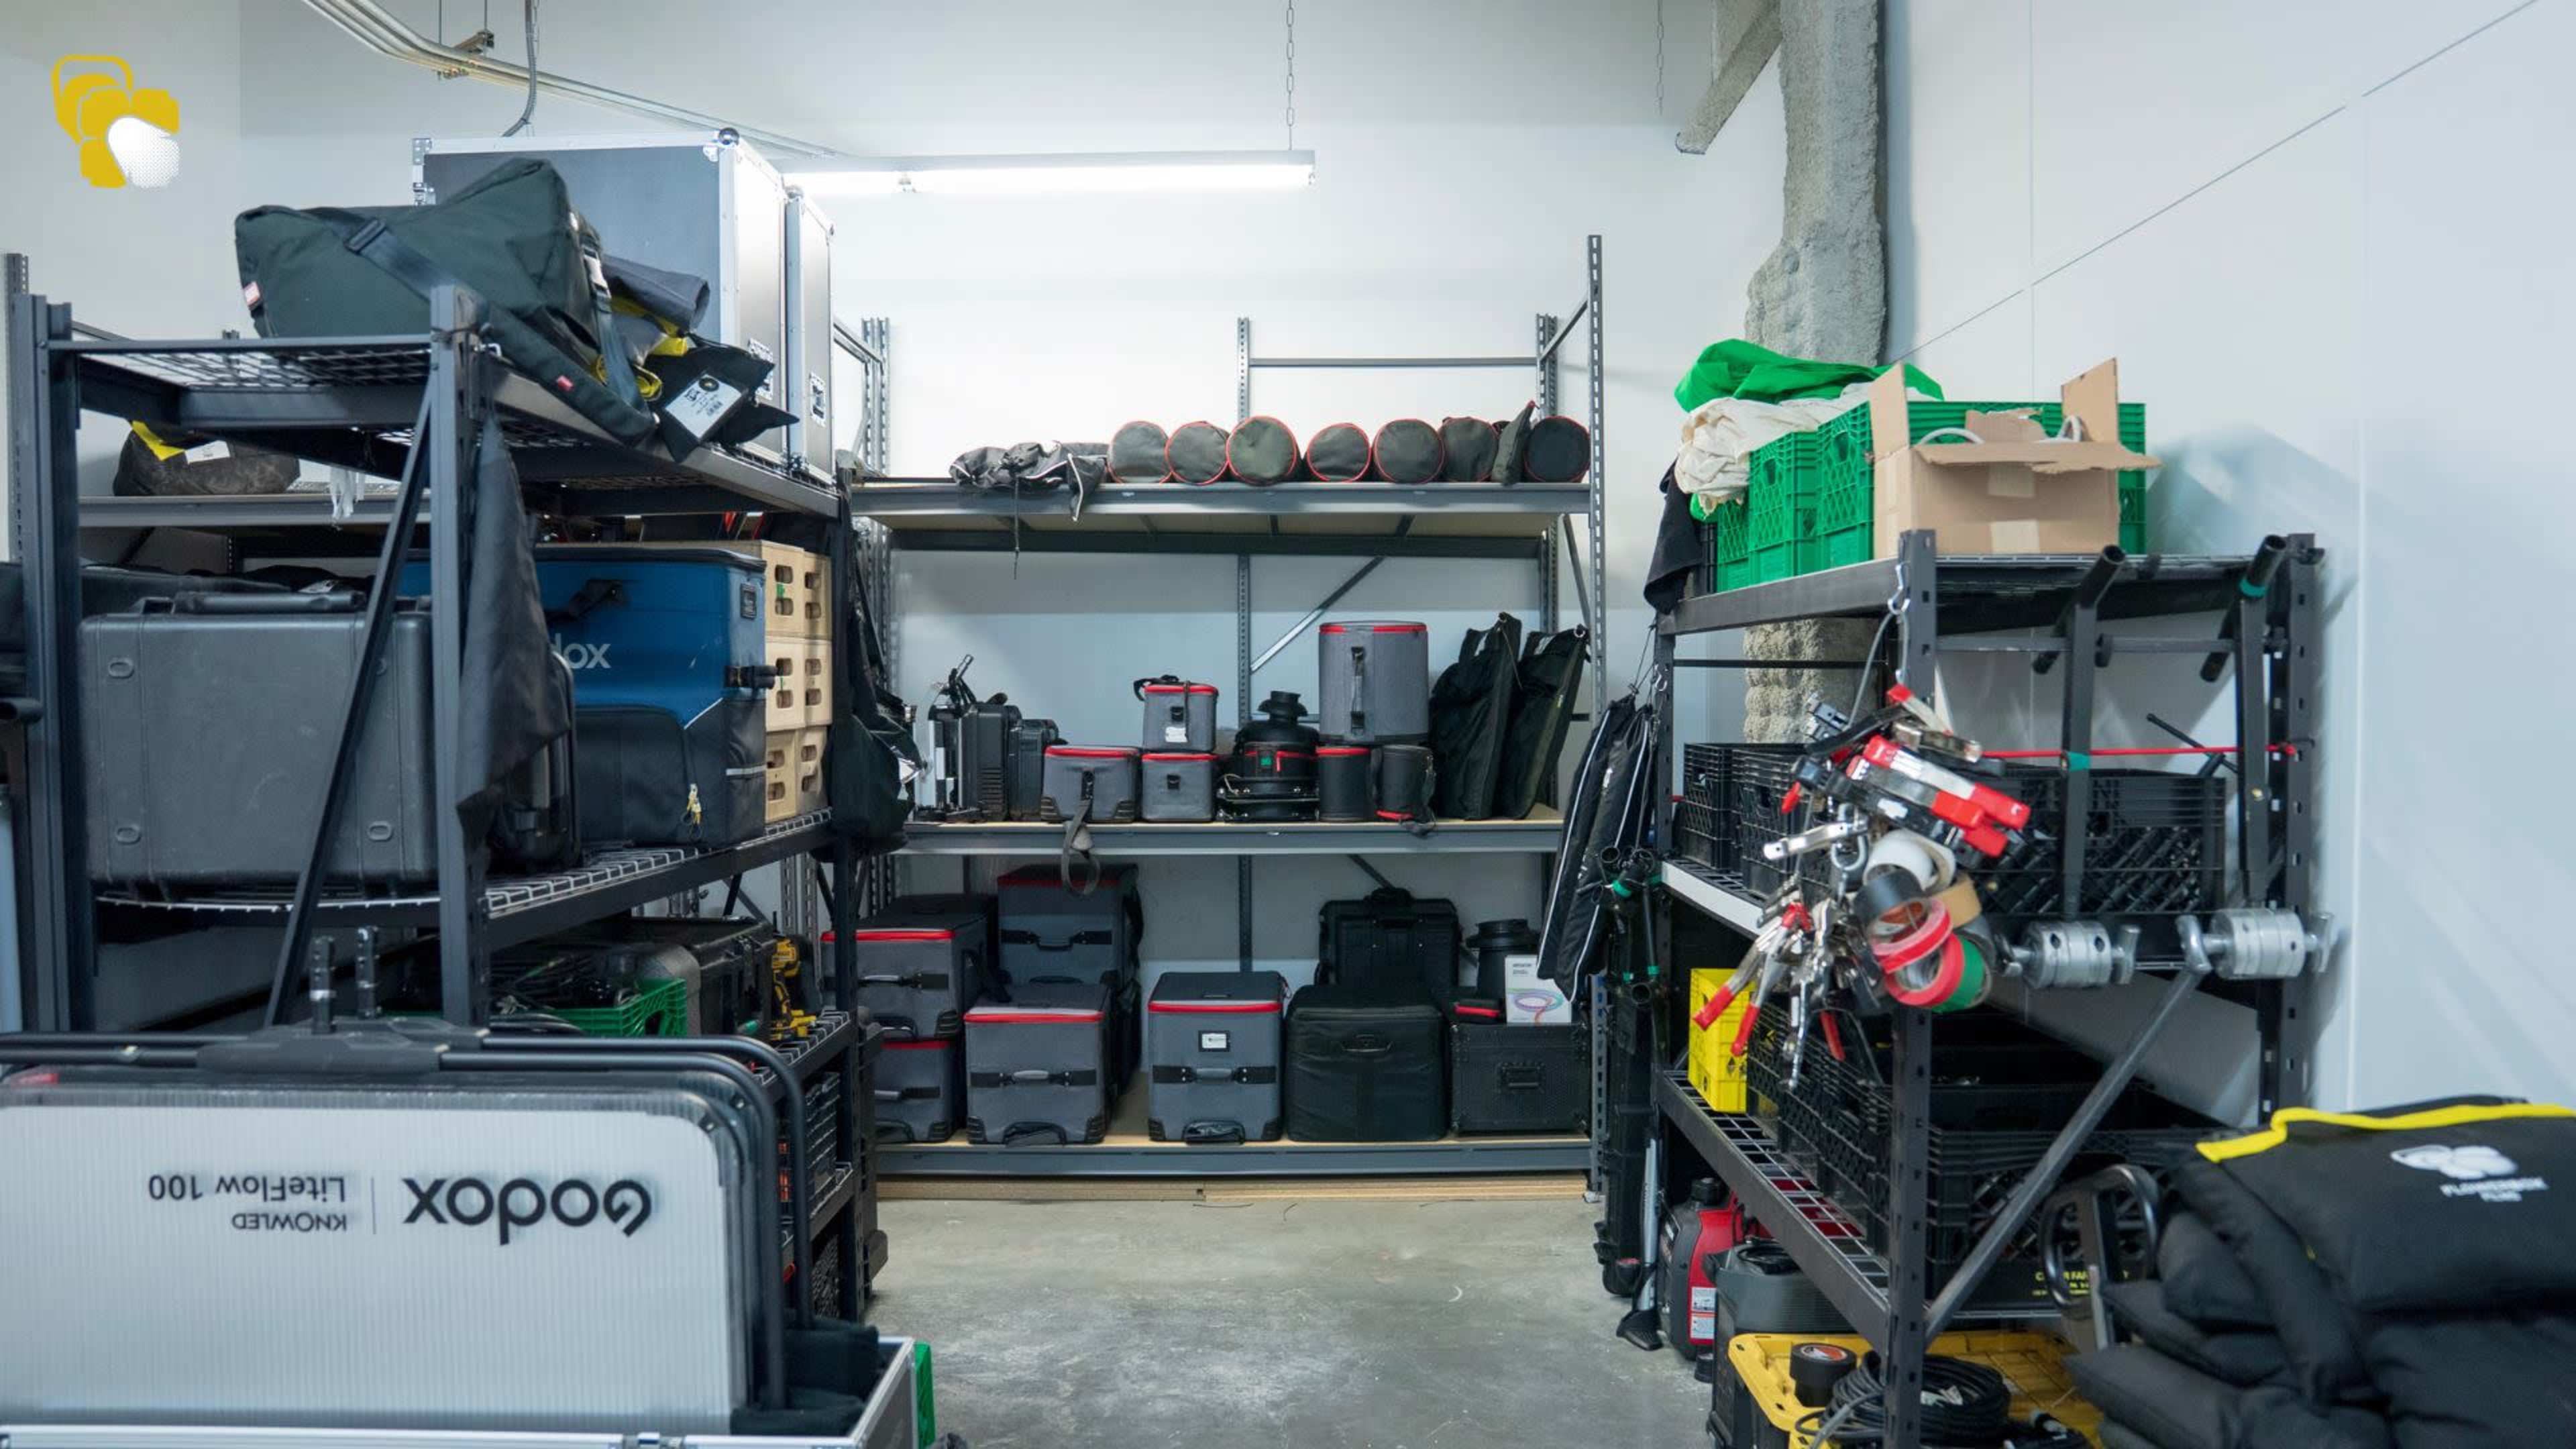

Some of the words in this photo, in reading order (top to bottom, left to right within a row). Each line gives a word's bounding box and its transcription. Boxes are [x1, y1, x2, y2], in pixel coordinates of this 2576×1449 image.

[148, 1175, 203, 1201] 100
[215, 1175, 345, 1202] LiteFlow
[231, 1212, 347, 1232] KNOWLED
[402, 1177, 652, 1246] Godox
